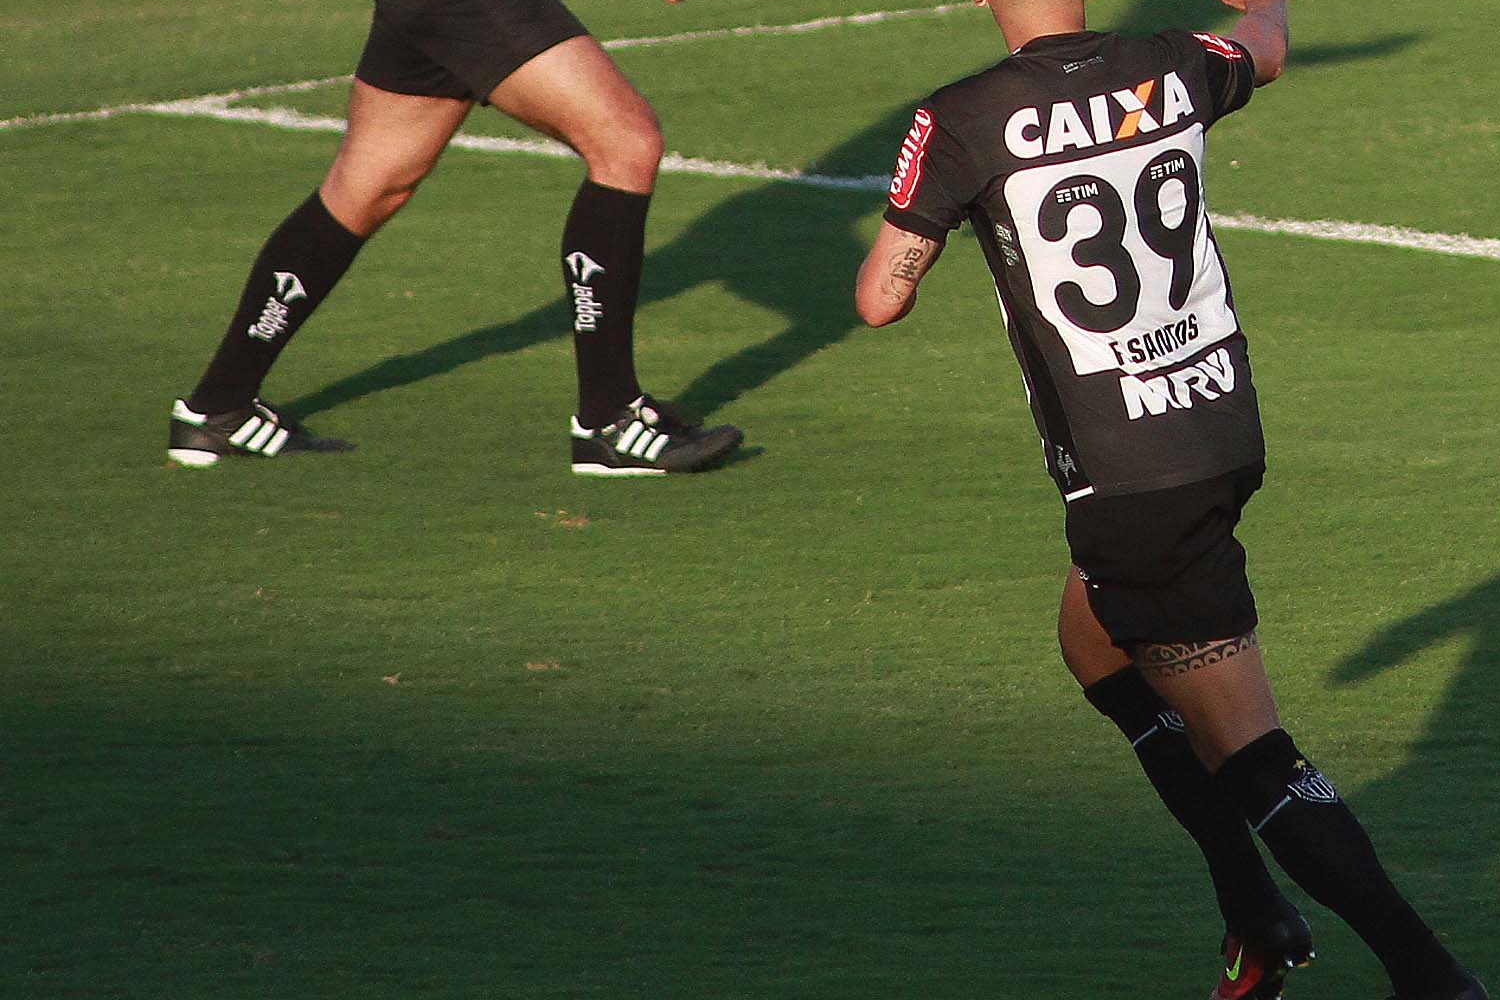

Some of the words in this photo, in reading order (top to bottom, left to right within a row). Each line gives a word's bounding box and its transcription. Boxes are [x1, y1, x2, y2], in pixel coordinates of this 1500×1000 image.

[1004, 71, 1195, 159] CAIXA
[1071, 183, 1099, 200] TIM
[1164, 157, 1186, 175] TIM
[1038, 149, 1199, 333] 39
[1127, 313, 1199, 364] SANTOS
[1119, 347, 1235, 420] MRV
